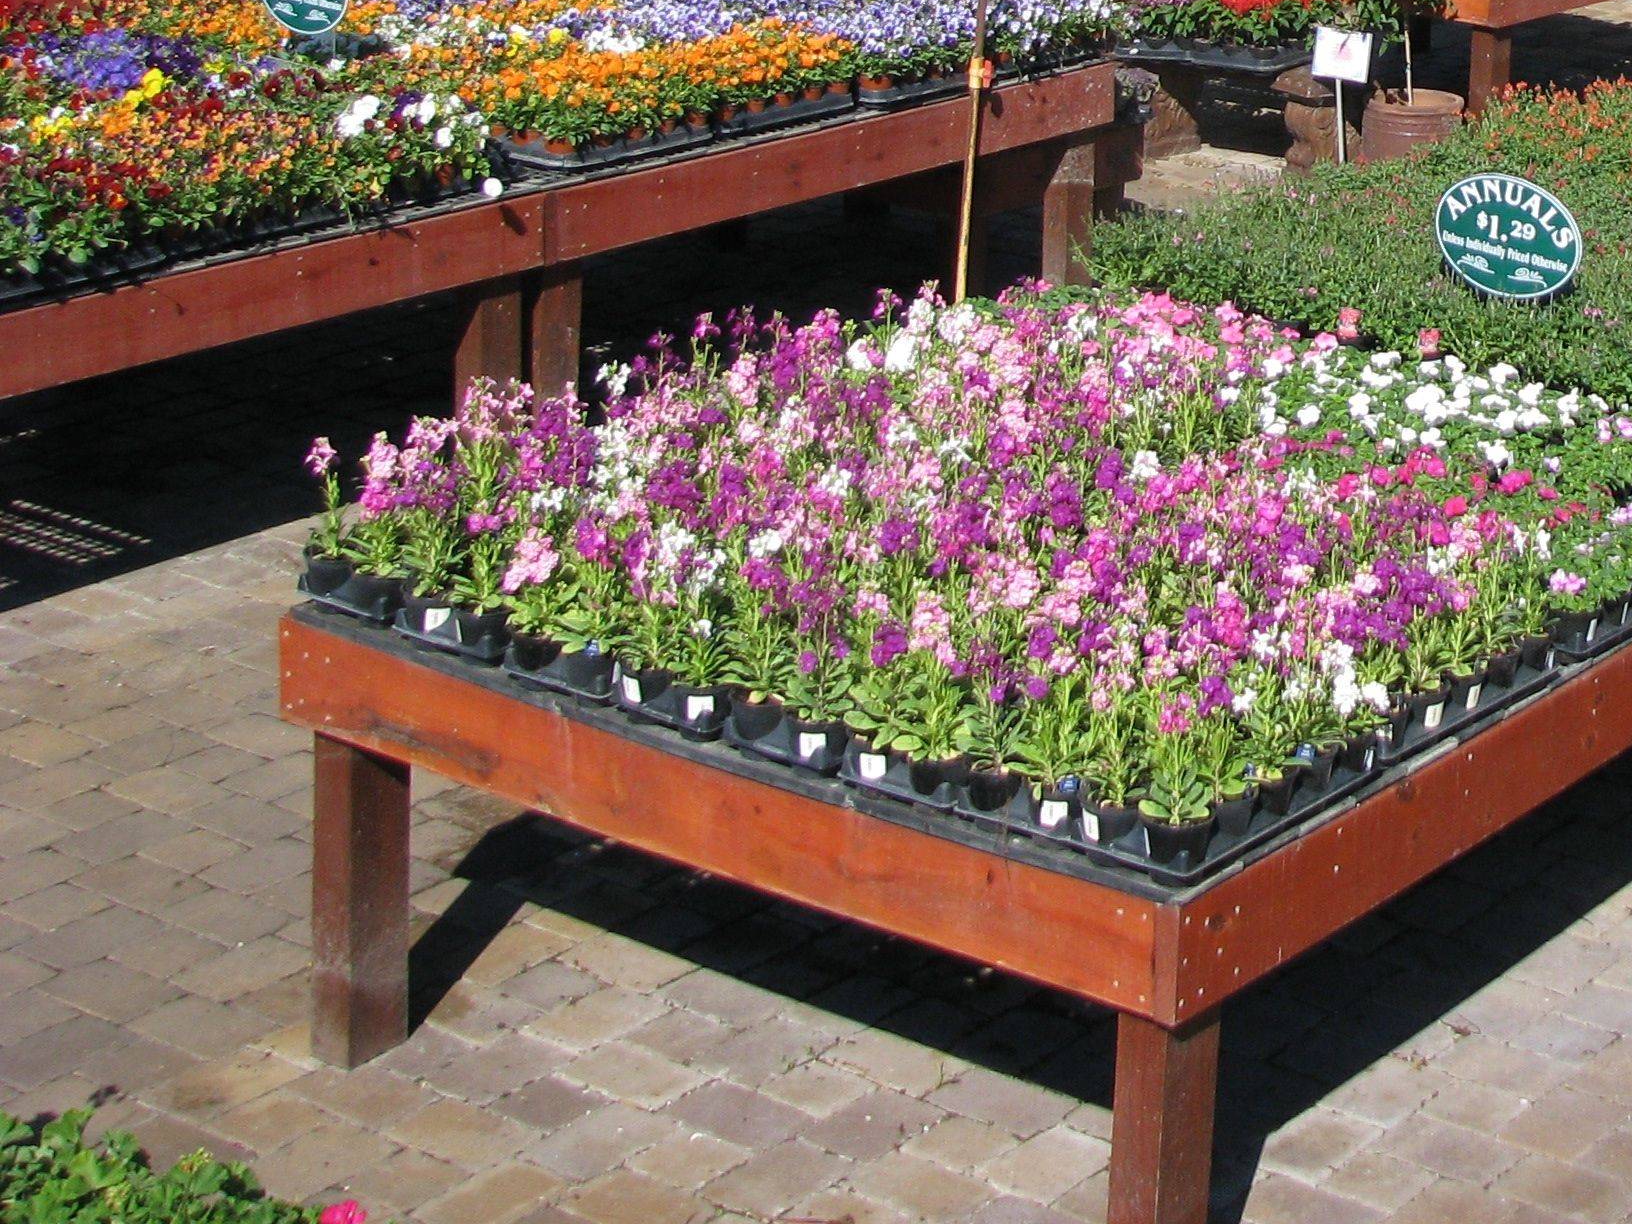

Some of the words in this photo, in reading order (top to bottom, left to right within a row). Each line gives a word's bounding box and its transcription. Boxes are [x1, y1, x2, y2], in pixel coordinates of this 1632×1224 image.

[1446, 179, 1574, 249] ANNUALS
[1442, 230, 1465, 247] Unless
[1465, 237, 1506, 260] Individually
[1507, 247, 1530, 264] Priced
[1531, 253, 1569, 273] Otherwise
